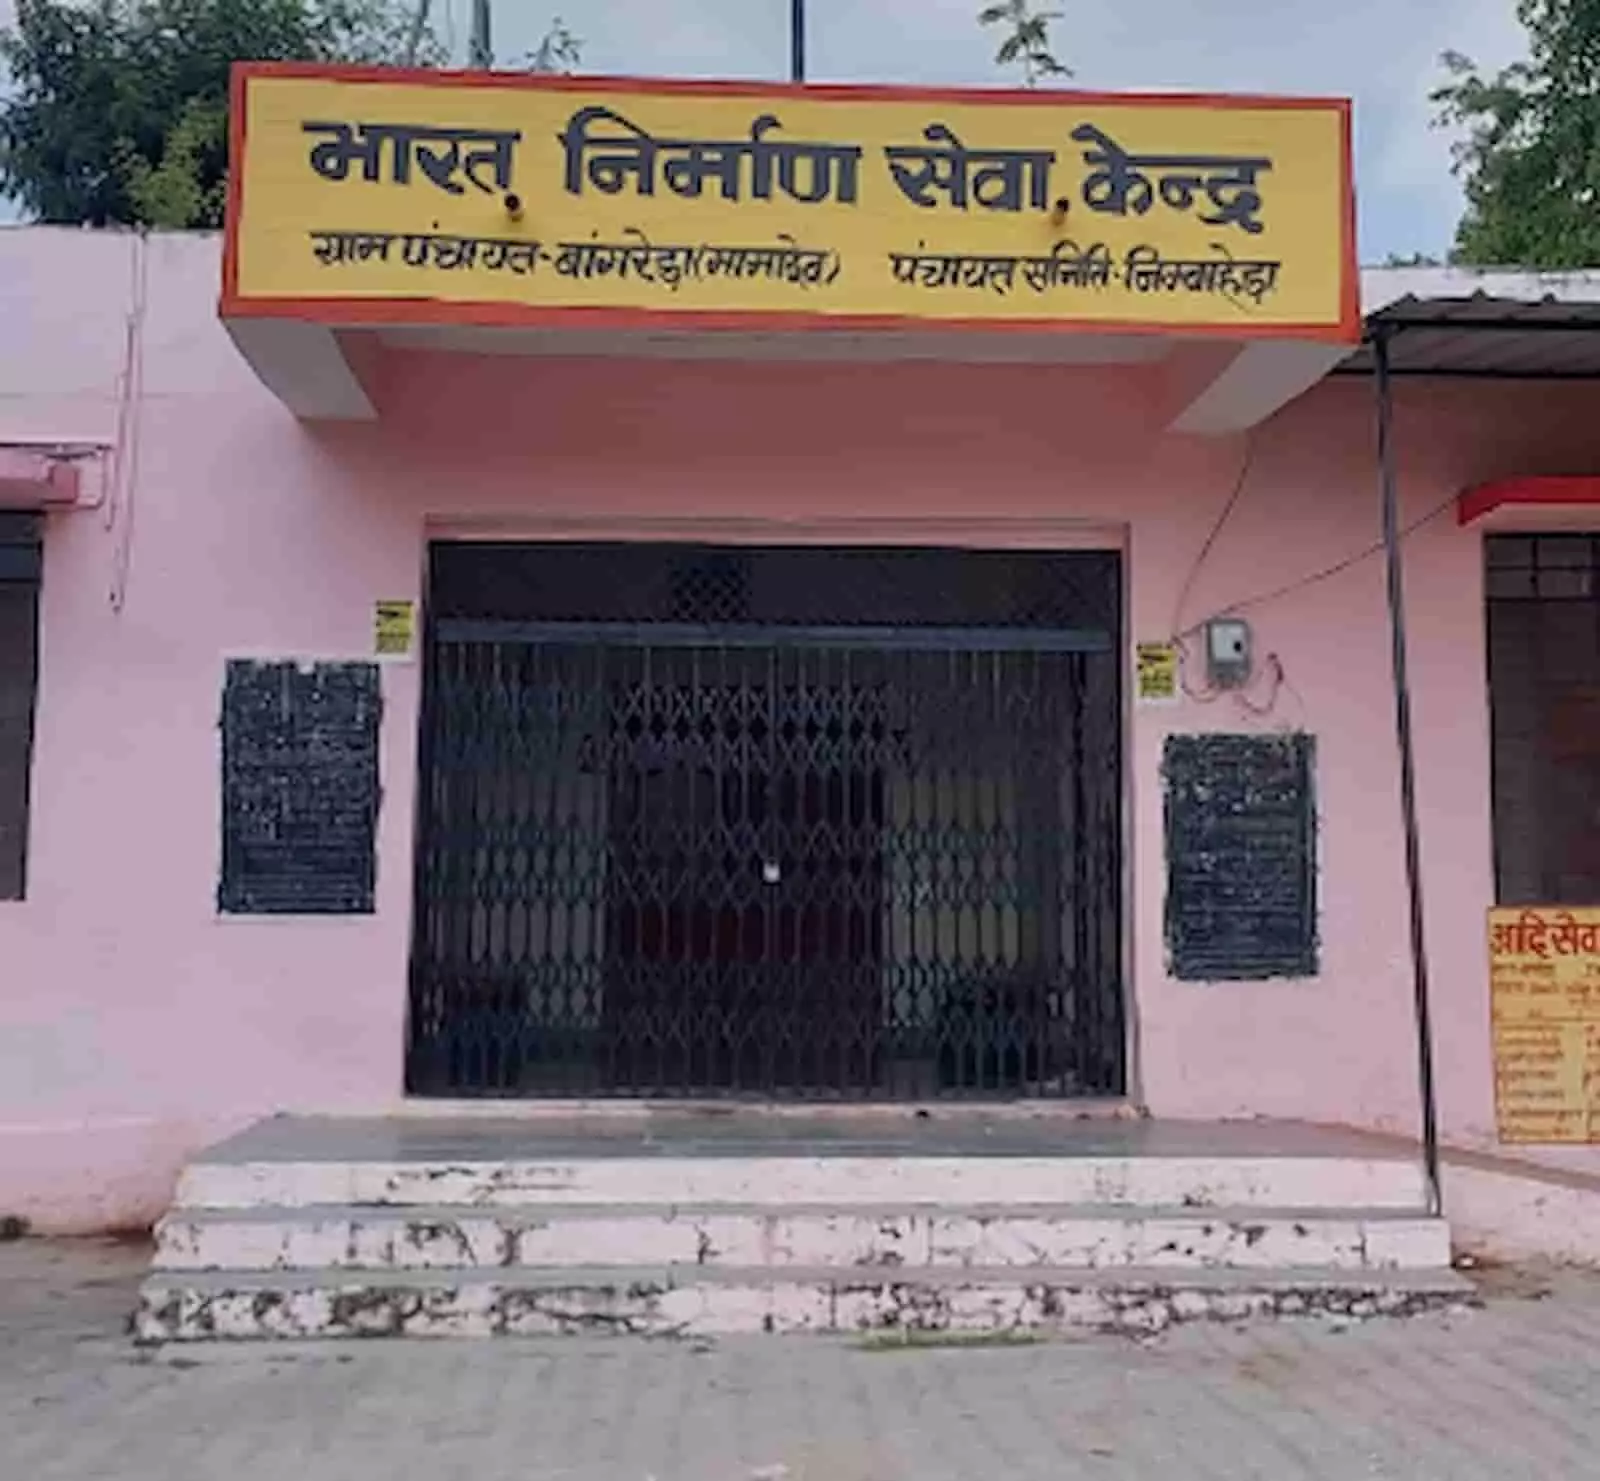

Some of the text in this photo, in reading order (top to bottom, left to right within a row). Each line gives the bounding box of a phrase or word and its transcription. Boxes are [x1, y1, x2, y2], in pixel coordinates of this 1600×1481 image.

[301, 106, 1273, 235] भारत निर्माण सेवा केन्द्र
[309, 231, 398, 266] ग्राम
[888, 240, 1017, 296] पंचायत
